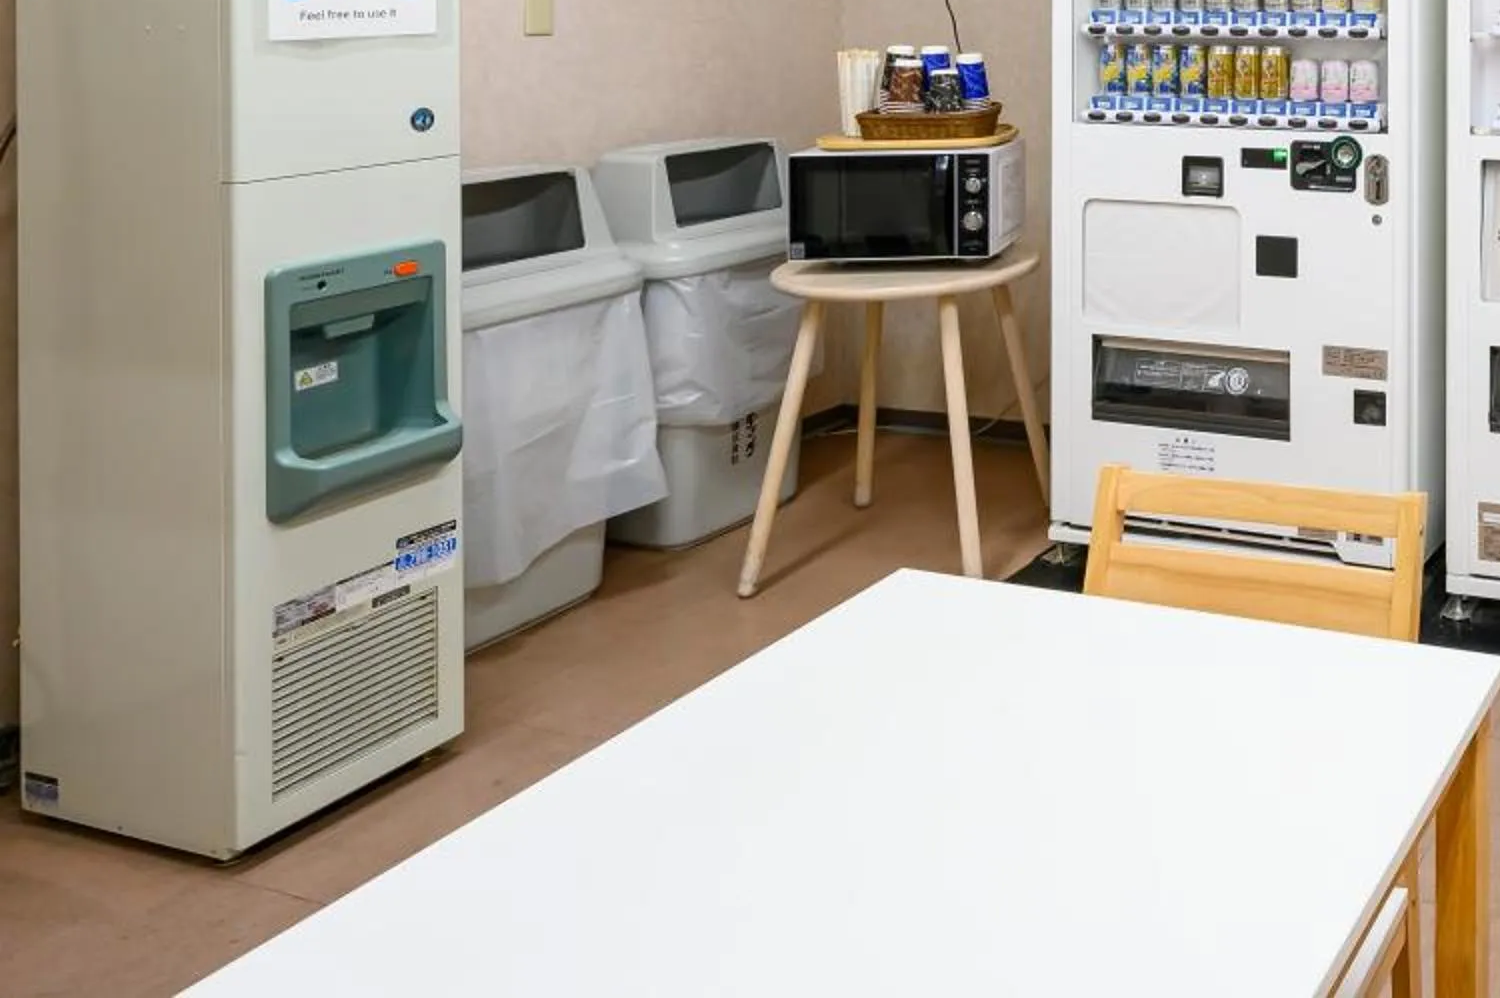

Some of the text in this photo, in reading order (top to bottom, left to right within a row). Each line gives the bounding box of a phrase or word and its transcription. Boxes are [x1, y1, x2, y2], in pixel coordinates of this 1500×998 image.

[299, 8, 325, 21] Feel
[327, 8, 350, 19] free
[353, 9, 365, 19] to
[367, 8, 387, 19] use
